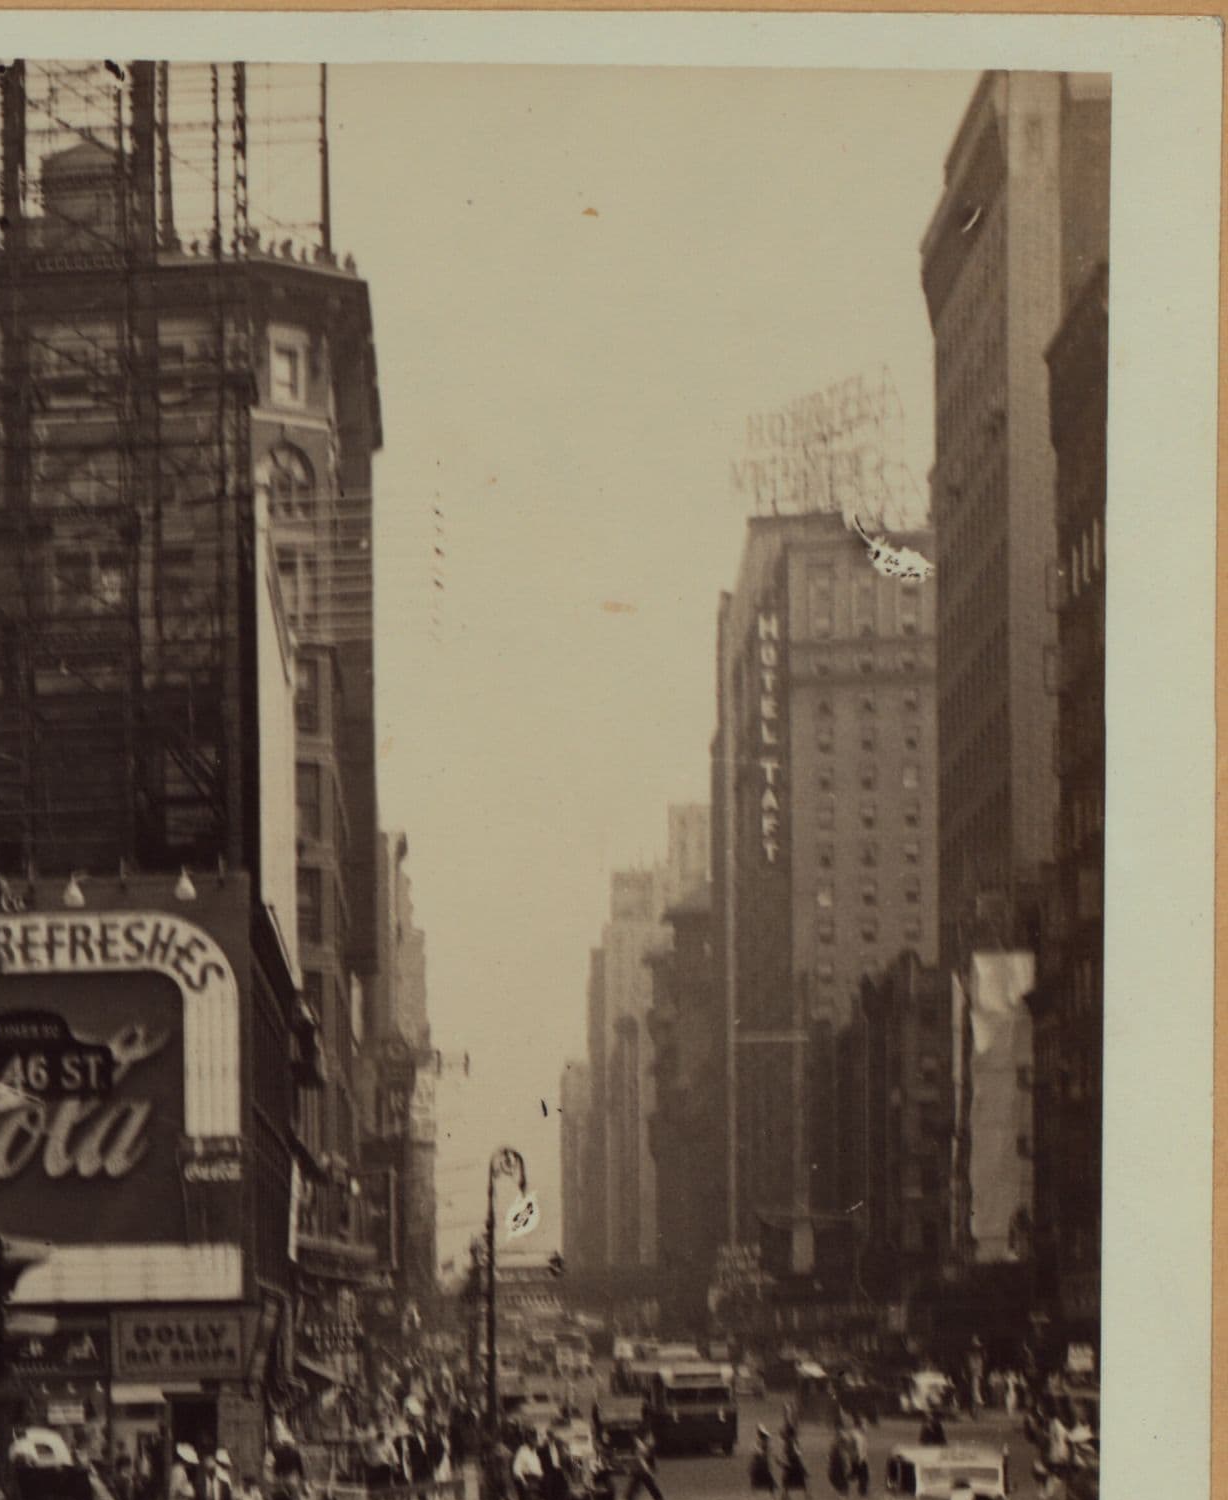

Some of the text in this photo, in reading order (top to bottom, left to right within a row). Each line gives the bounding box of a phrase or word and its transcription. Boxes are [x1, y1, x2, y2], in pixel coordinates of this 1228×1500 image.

[757, 612, 781, 862] HOTEL TAFT
[1, 1052, 50, 1092] 46
